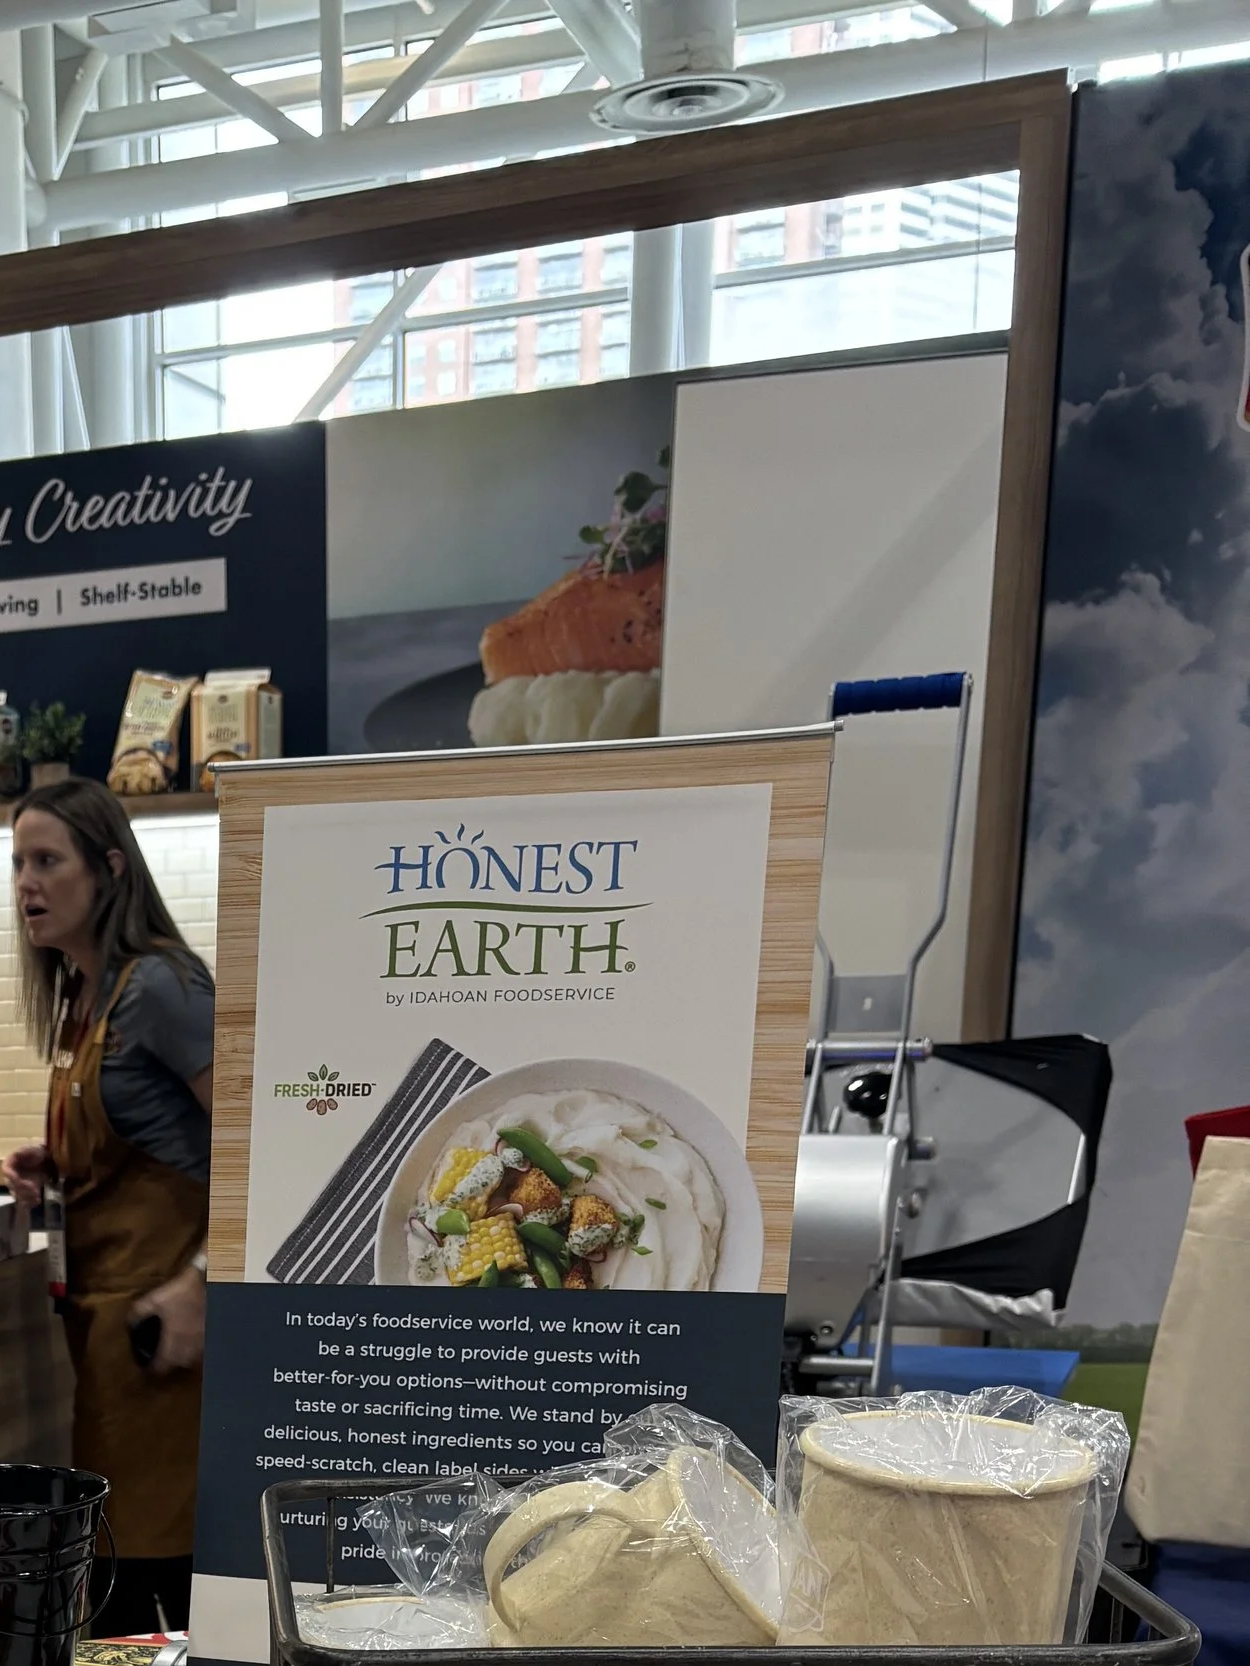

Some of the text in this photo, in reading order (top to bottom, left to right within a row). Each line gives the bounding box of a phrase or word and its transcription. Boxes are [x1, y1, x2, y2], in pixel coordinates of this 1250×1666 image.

[24, 466, 253, 537] Creativity
[80, 578, 202, 606] Shelf-Stable
[374, 838, 638, 894] HONEST
[386, 987, 615, 1007] by IDAHOAN FOODSERVICE
[287, 1312, 301, 1325] In
[373, 1313, 472, 1329] foodservice
[479, 1316, 533, 1332] world,
[540, 1321, 566, 1332] we
[573, 1318, 623, 1333] know
[629, 1318, 642, 1335] it
[647, 1324, 680, 1335] can
[319, 1341, 639, 1364] be a struggle to provide guests with
[274, 1368, 390, 1388] better-for-you
[552, 1381, 687, 1400] compromising
[295, 1399, 336, 1412] taste
[342, 1403, 359, 1413] or
[364, 1402, 452, 1420] sacrificing
[459, 1404, 502, 1419] time.
[510, 1406, 537, 1420] We
[543, 1409, 593, 1423] stand
[601, 1409, 622, 1427] by
[265, 1425, 341, 1442] delicious,
[348, 1428, 406, 1444] honest
[413, 1431, 512, 1449] ingredients
[518, 1439, 537, 1450] so
[543, 1440, 574, 1454] you
[256, 1455, 376, 1473] speed-scratch,
[383, 1459, 428, 1474] clean
[435, 1460, 479, 1476] label
[341, 1544, 387, 1561] pride
